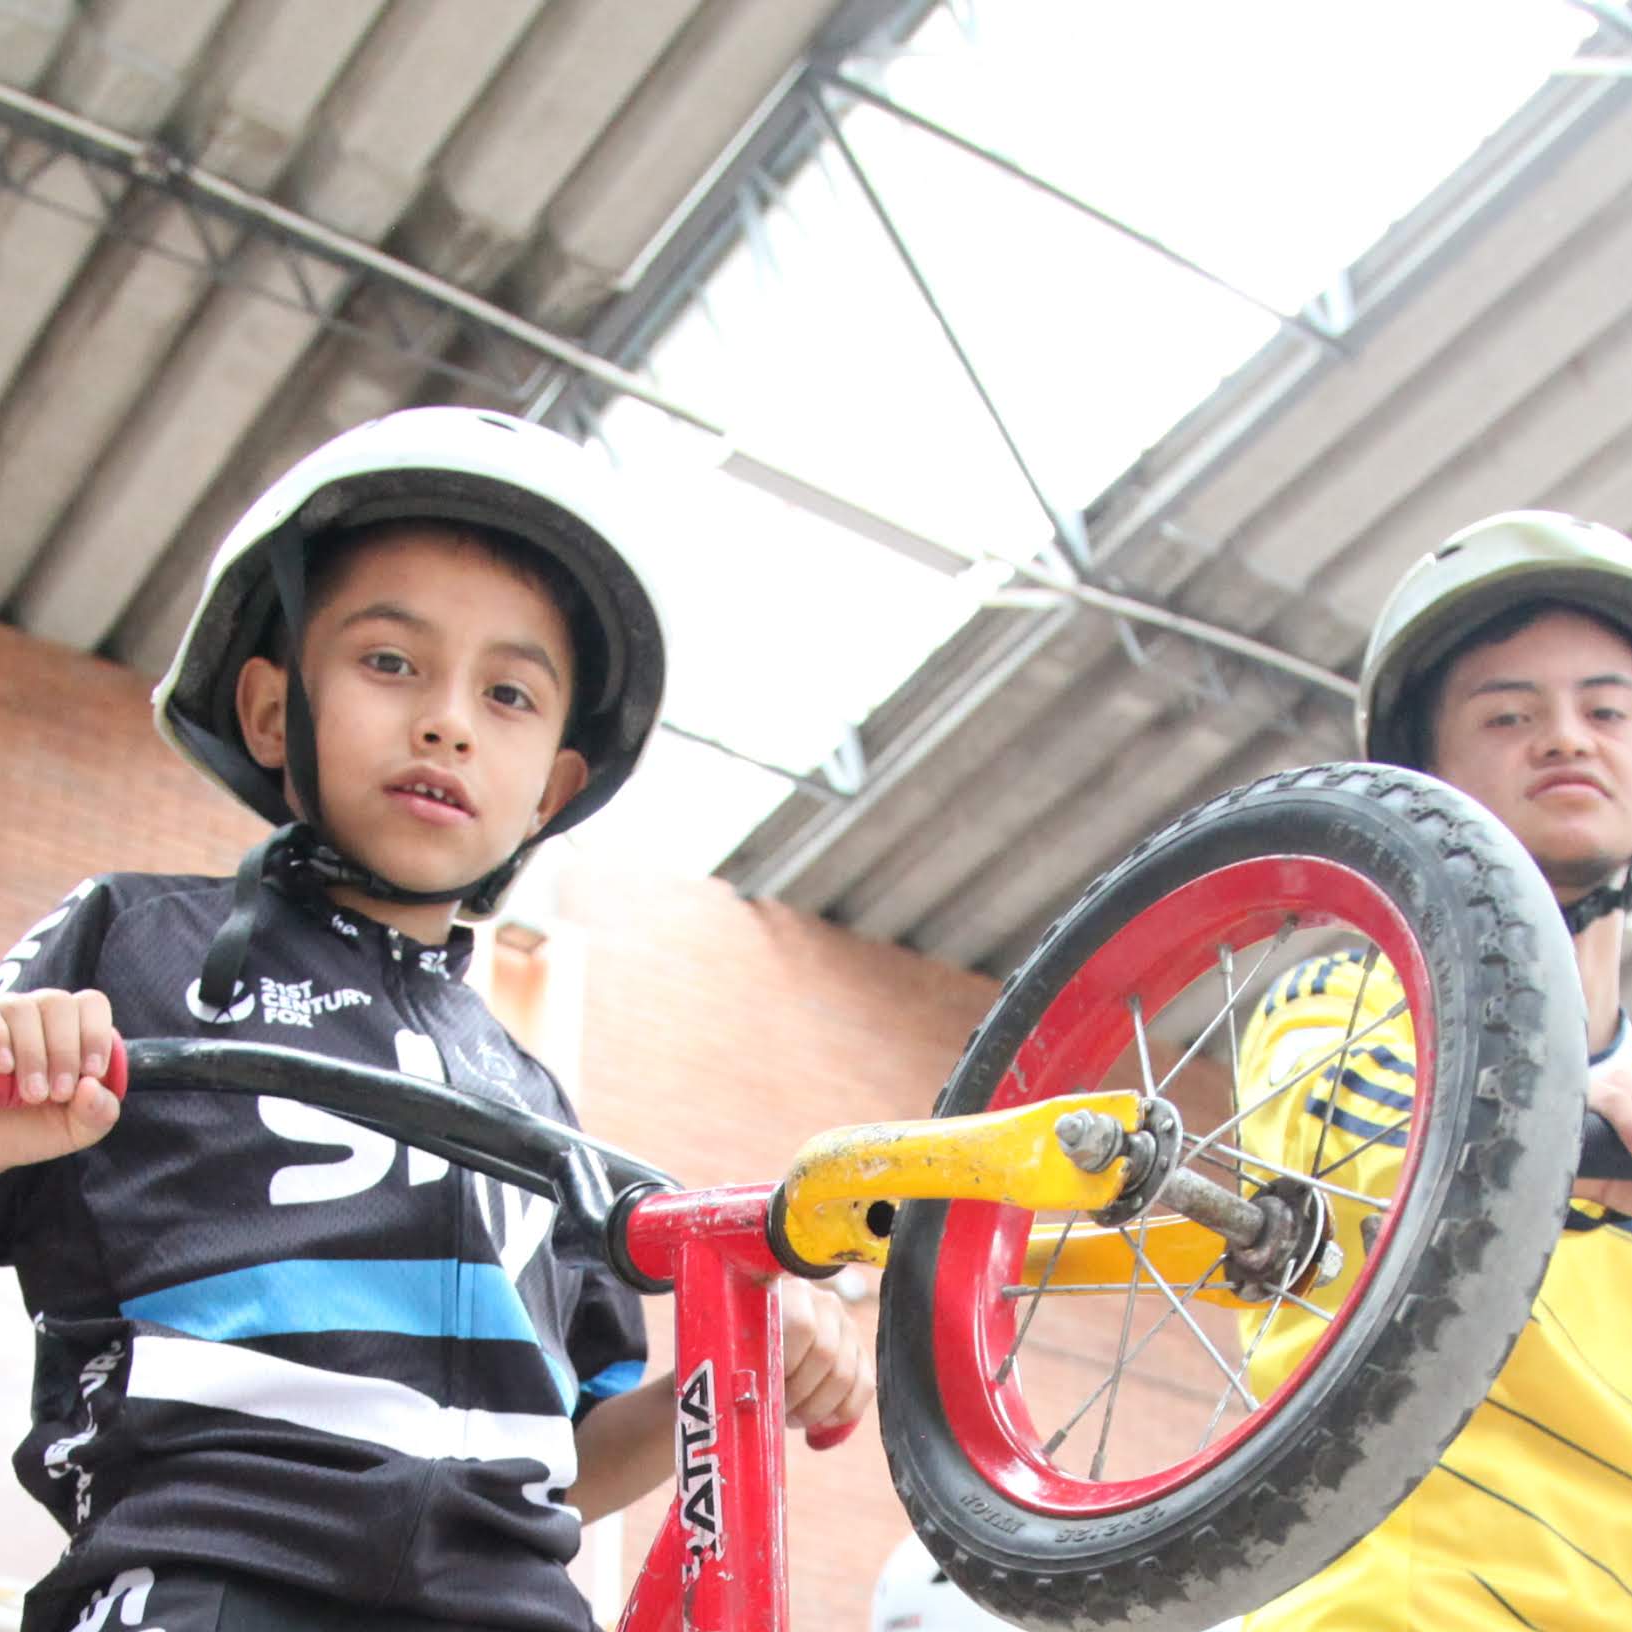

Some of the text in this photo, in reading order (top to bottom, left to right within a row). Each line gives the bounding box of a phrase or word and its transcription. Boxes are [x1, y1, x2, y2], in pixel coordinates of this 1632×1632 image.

[260, 977, 313, 1000] 21ST
[260, 988, 372, 1015] CENTURY
[263, 1007, 313, 1029] FOX
